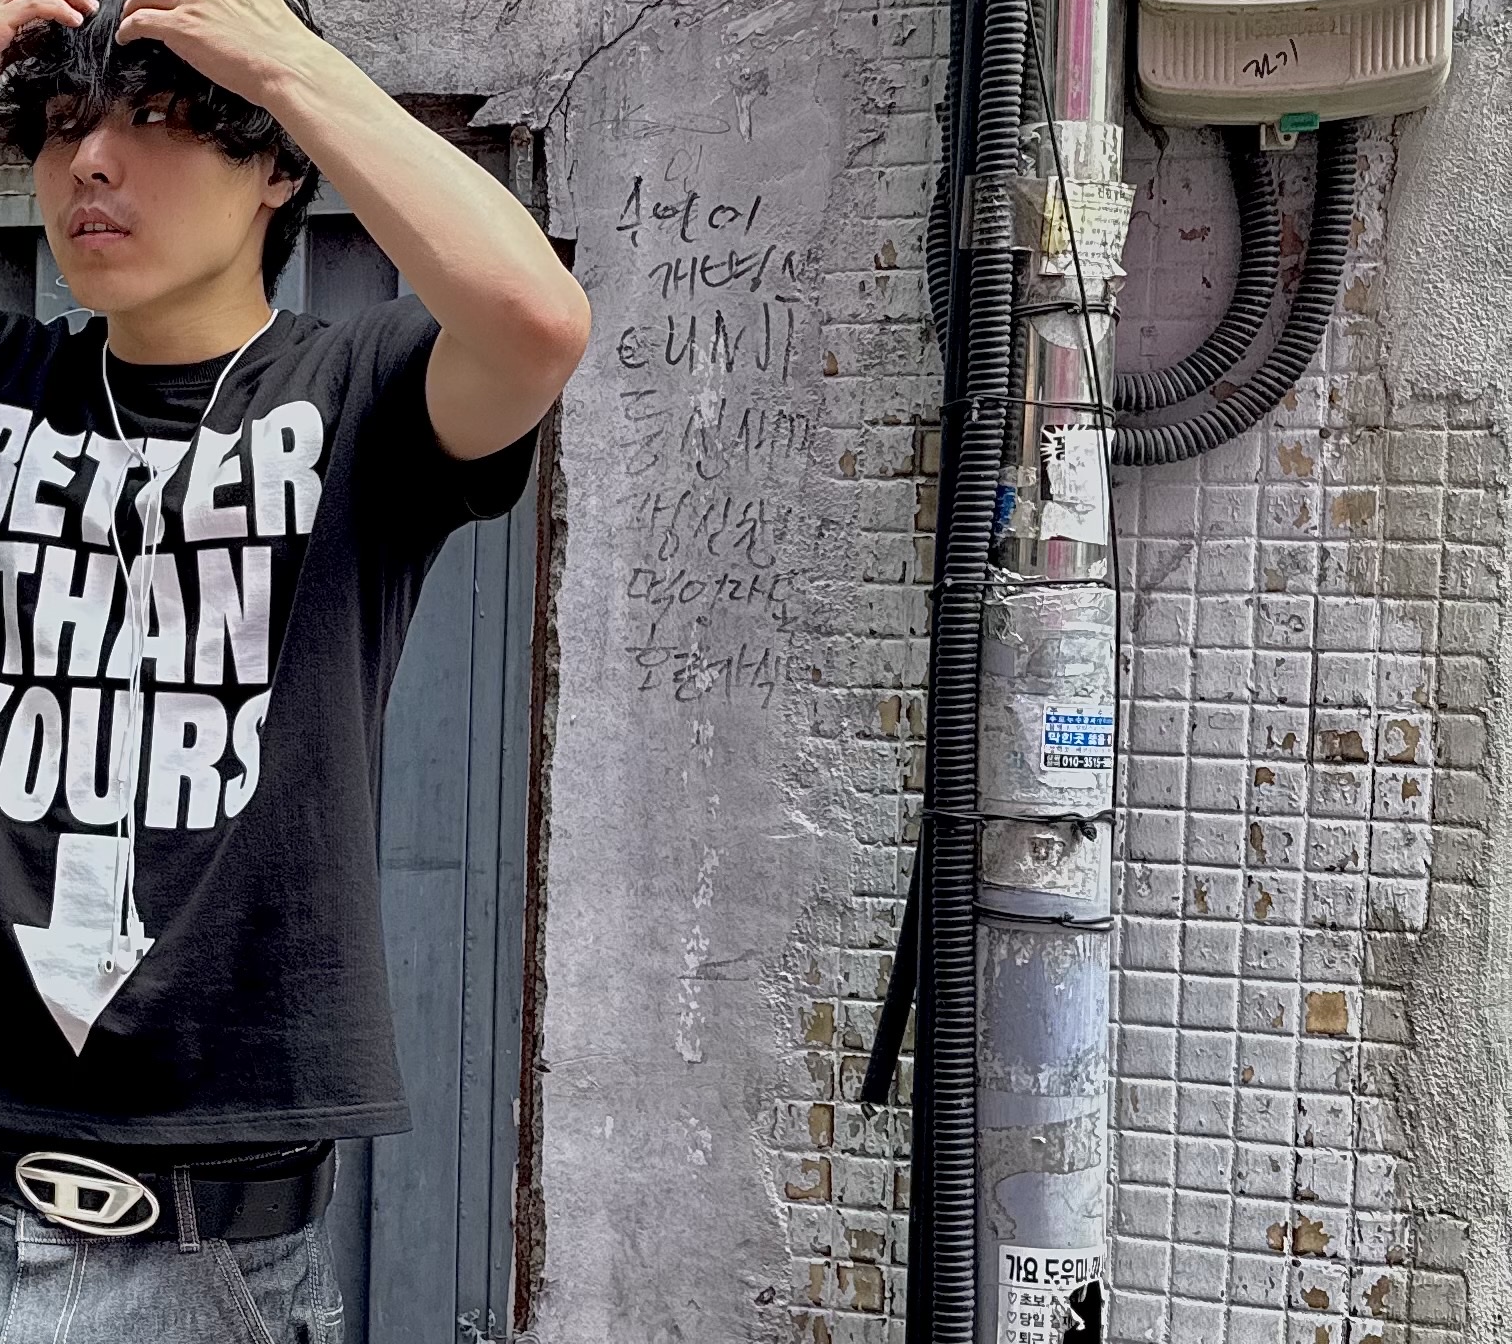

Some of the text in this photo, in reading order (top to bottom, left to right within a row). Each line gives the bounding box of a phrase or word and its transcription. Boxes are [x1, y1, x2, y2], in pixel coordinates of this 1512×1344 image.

[1048, 732, 1085, 745] 막힌곳
[1006, 1254, 1039, 1283] 가요
[1043, 1258, 1088, 1285] 도우미
[1020, 1293, 1045, 1307] 초보
[1020, 1312, 1045, 1327] 당일
